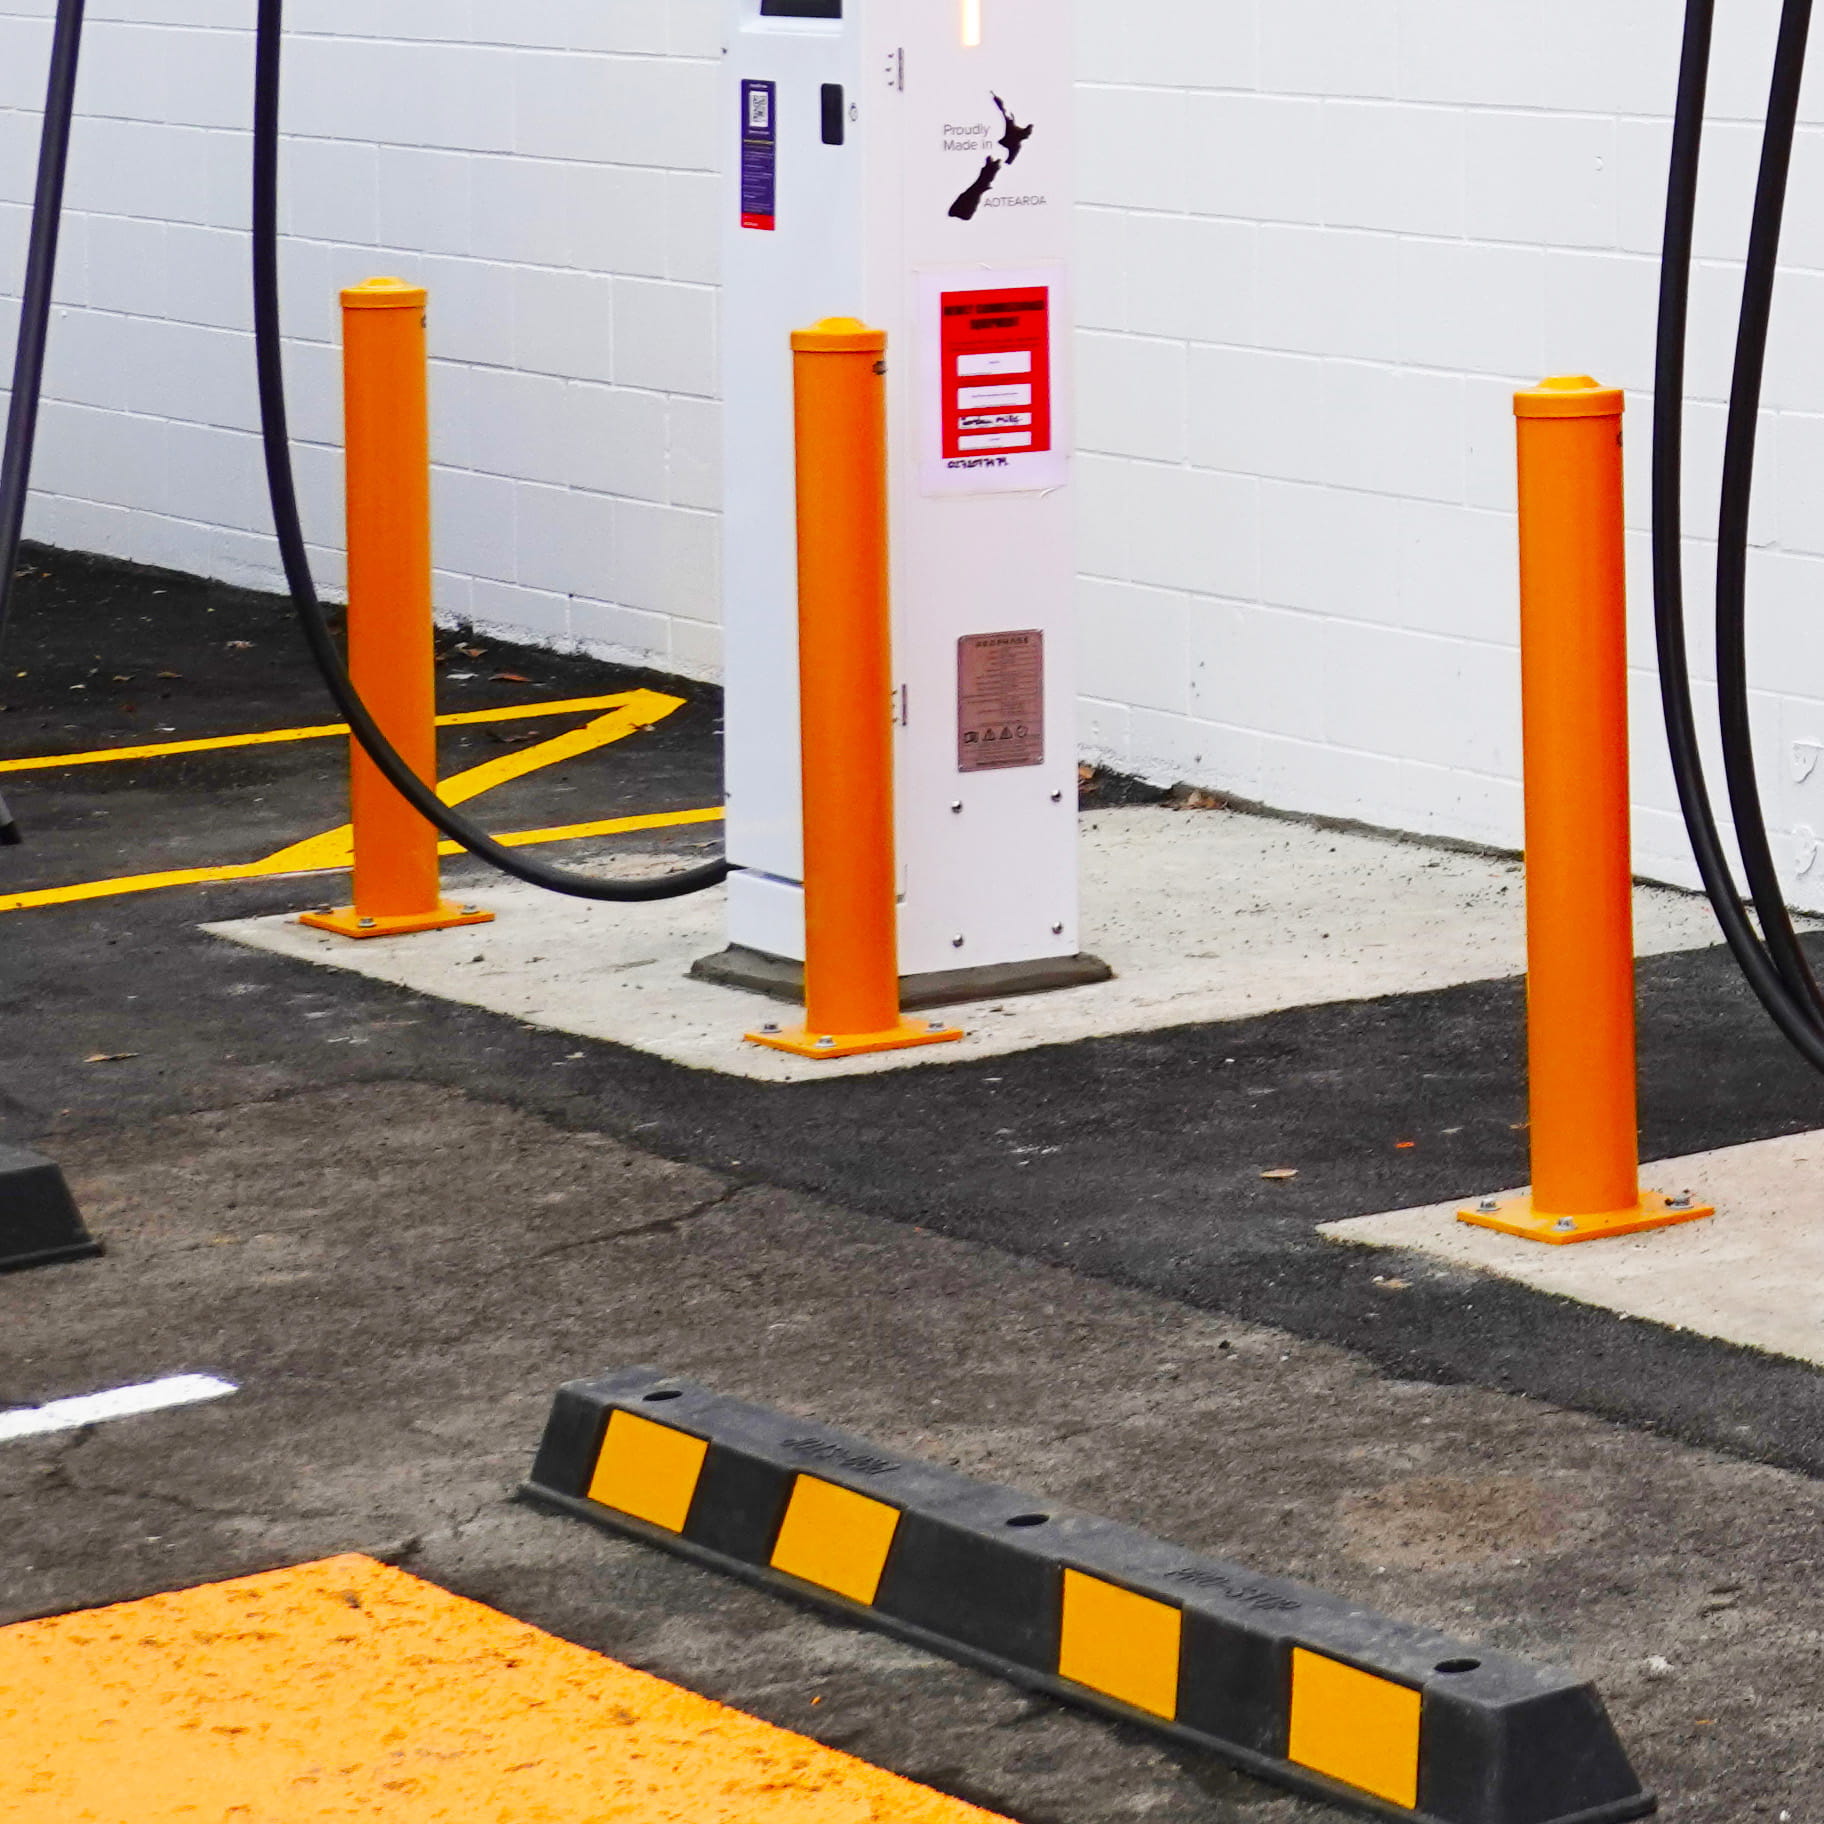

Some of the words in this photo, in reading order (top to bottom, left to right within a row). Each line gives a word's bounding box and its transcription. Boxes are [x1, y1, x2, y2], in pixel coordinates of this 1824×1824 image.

[943, 123, 990, 137] Proudly
[943, 140, 978, 151] Made
[982, 139, 992, 150] in
[984, 196, 1047, 207] AOTEAROA
